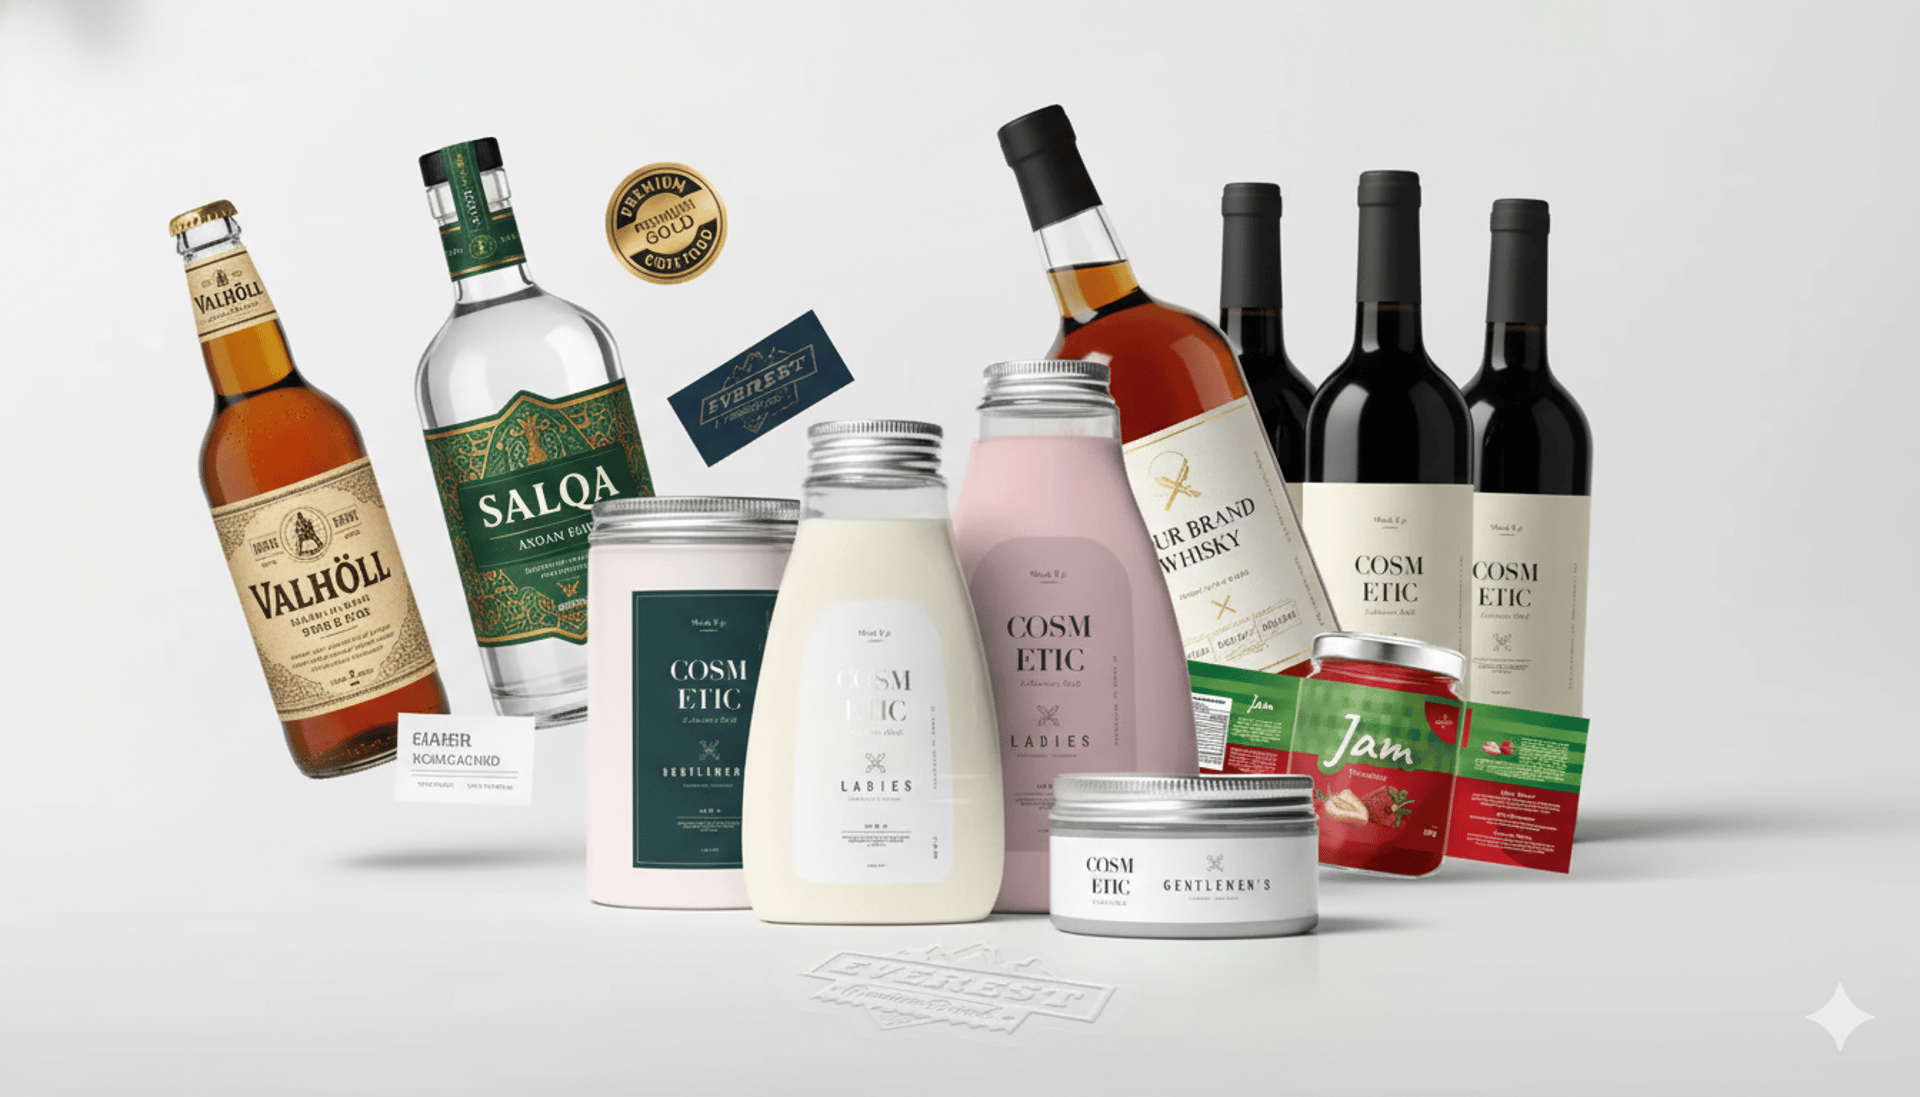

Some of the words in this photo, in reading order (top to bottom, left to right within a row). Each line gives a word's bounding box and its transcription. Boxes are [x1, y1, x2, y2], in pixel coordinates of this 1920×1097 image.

[478, 464, 620, 528] SALQA
[1186, 497, 1255, 539] BRAND
[1158, 529, 1241, 574] WHISKY
[1354, 555, 1423, 575] COSM
[1472, 561, 1538, 582] COSM
[248, 551, 391, 619] VALHÖLL
[1363, 582, 1418, 602] ETIC
[1478, 587, 1531, 608] ETIC
[1006, 614, 1091, 639] COSM
[669, 659, 747, 681] COSM
[1016, 648, 1085, 672] ETIC
[678, 688, 741, 710] ETIC
[1010, 735, 1090, 748] LADIES
[1323, 713, 1413, 768] Jam
[1086, 856, 1134, 874] COSM
[1091, 878, 1131, 896] ETIC
[830, 961, 1085, 1008] EVEREST
